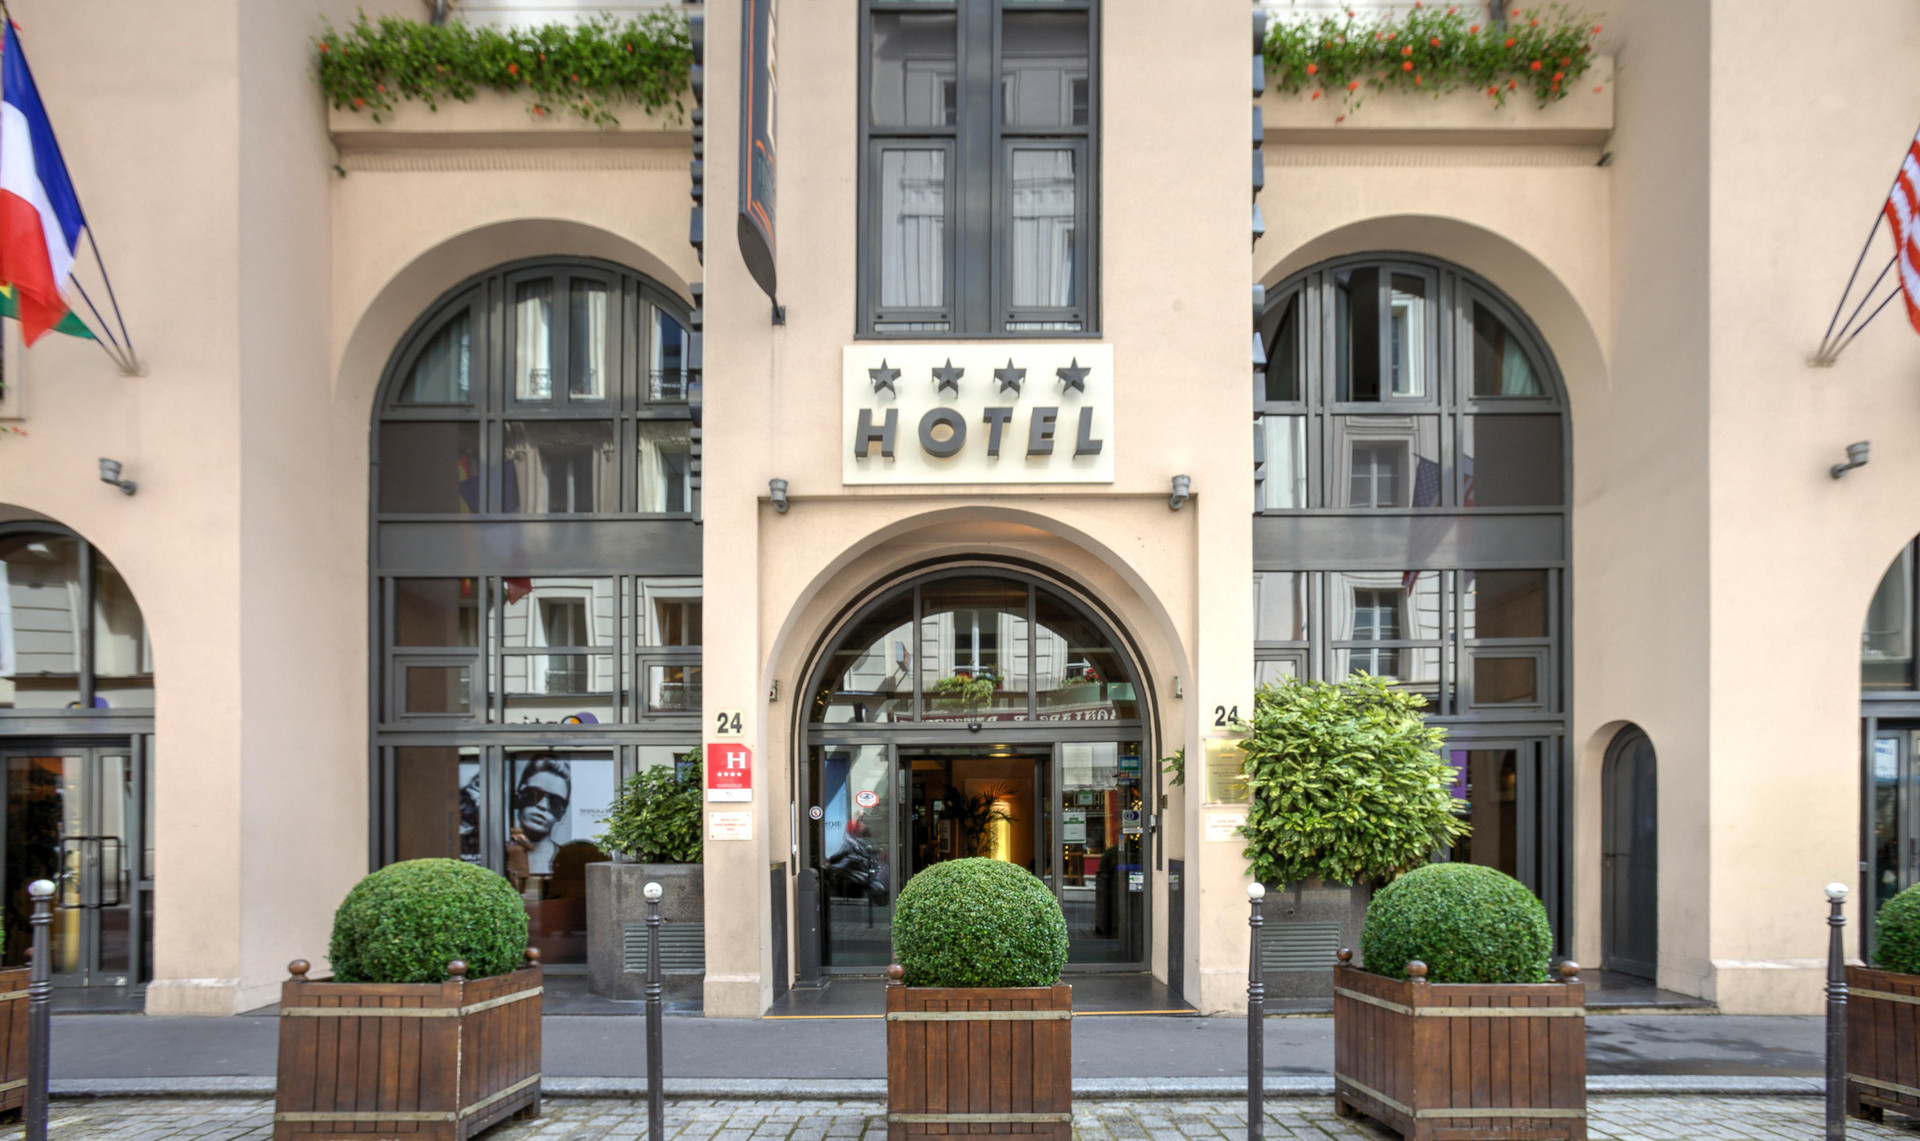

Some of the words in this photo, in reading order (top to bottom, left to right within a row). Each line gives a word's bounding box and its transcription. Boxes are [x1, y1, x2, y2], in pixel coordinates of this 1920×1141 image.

[855, 407, 1103, 459] HOTEL
[717, 712, 742, 734] 24
[1214, 705, 1239, 727] 24
[726, 752, 747, 769] H
